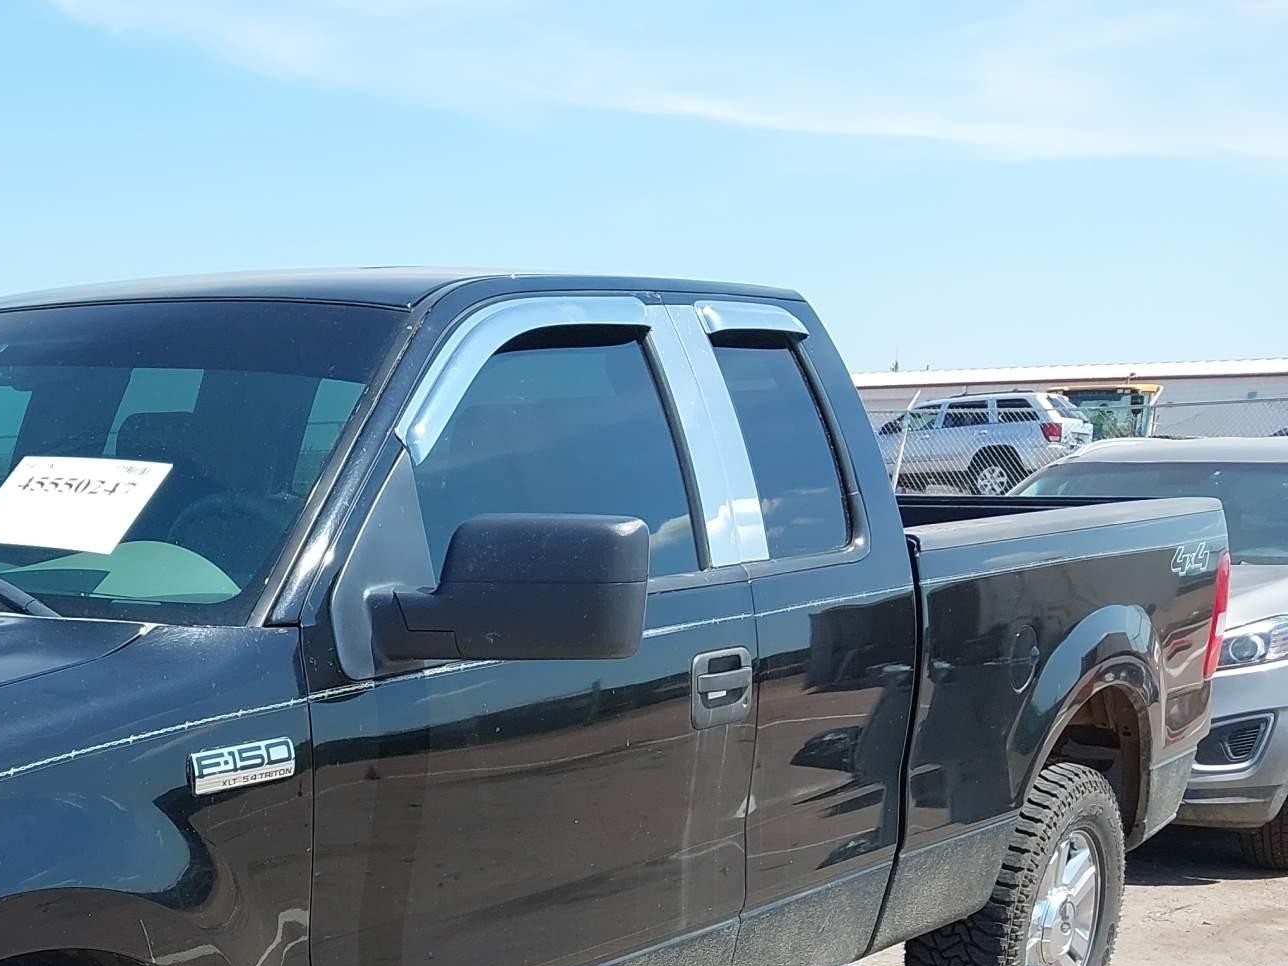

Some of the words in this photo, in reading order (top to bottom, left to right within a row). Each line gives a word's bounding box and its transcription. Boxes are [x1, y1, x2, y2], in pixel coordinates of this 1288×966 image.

[17, 476, 136, 496] 45550247
[1170, 541, 1210, 576] 4x4
[260, 767, 292, 779] TRITON
